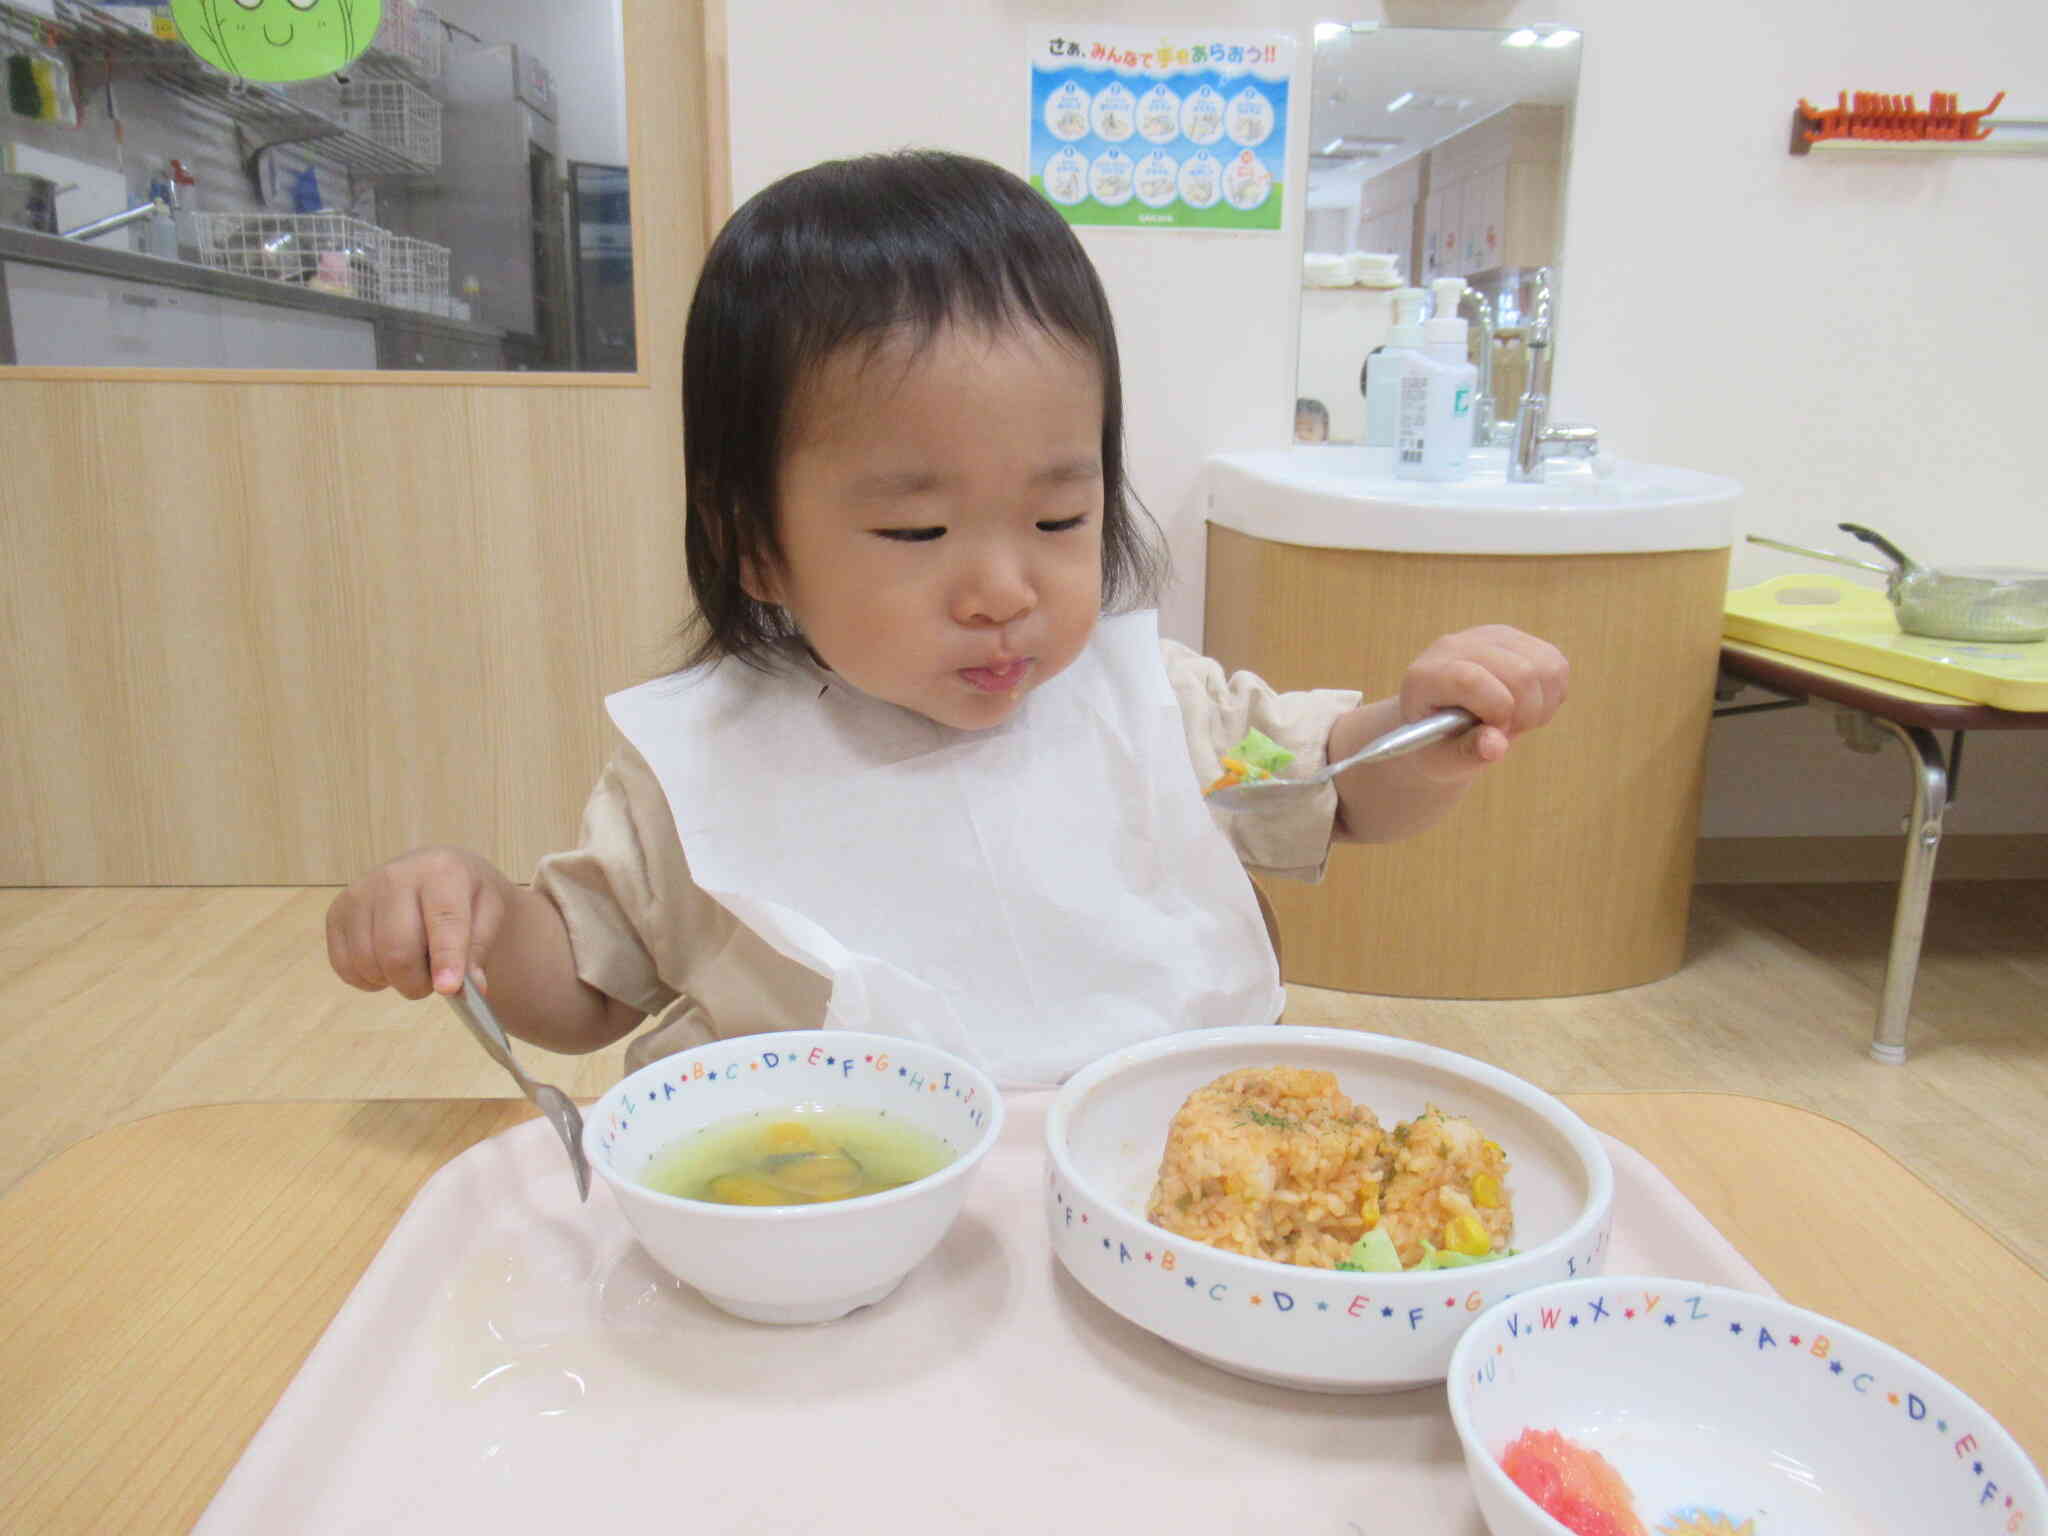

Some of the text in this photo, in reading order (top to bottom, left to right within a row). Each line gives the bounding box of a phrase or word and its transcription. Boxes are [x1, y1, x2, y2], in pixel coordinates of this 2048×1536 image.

[663, 1082, 677, 1101] A
[692, 1062, 706, 1081] B
[725, 1063, 740, 1080] C
[762, 1052, 780, 1069] D
[807, 1047, 824, 1066] E
[842, 1059, 856, 1079] F
[875, 1053, 889, 1072] G
[908, 1071, 926, 1093] H
[943, 1072, 952, 1090] I
[1118, 1241, 1132, 1264] A
[1160, 1250, 1176, 1272] B
[1209, 1283, 1228, 1301] C
[1273, 1291, 1294, 1312] D
[1347, 1294, 1370, 1318] E
[1408, 1307, 1423, 1331] F
[1465, 1290, 1483, 1313] G
[1567, 1256, 1577, 1278] I
[1506, 1312, 1519, 1337] V
[1540, 1306, 1562, 1329] W
[1587, 1296, 1610, 1323] X
[1643, 1291, 1661, 1313] Y
[1684, 1295, 1710, 1320] Z
[1758, 1326, 1777, 1349] A
[1809, 1334, 1830, 1359] B
[1852, 1373, 1875, 1393] C
[1908, 1391, 1926, 1421] D
[1955, 1434, 1978, 1459] E
[1979, 1479, 1998, 1505] F
